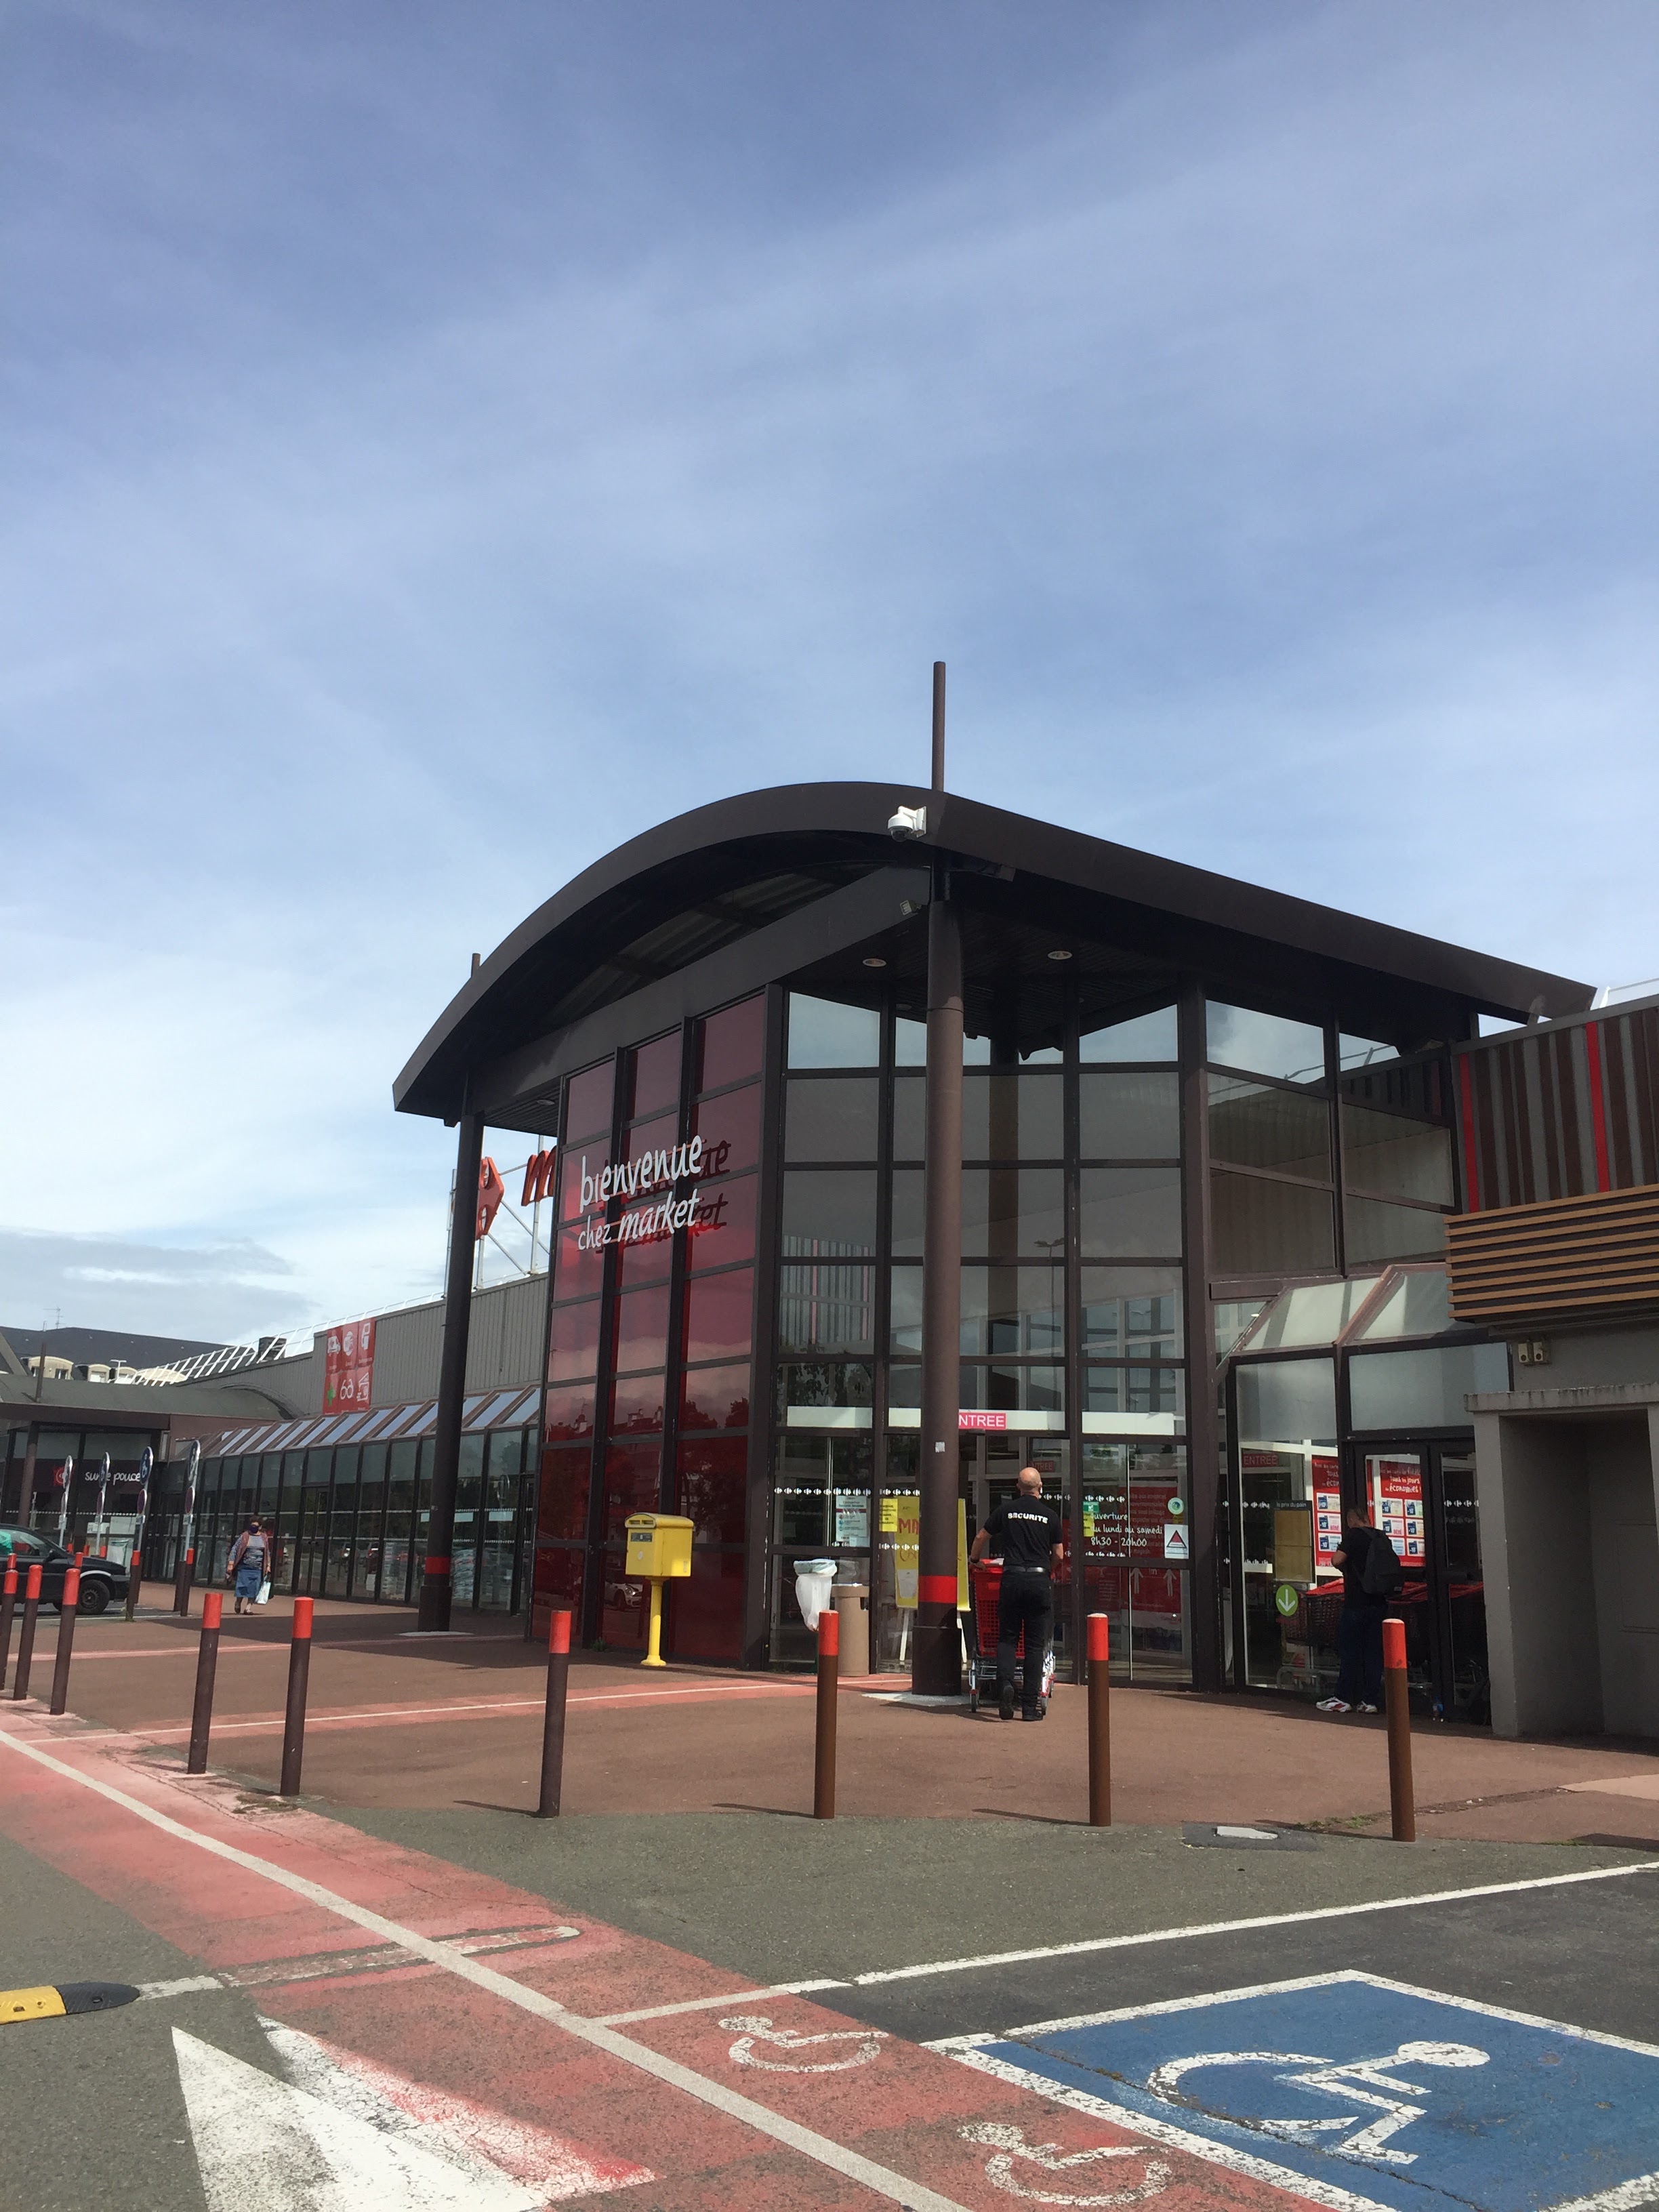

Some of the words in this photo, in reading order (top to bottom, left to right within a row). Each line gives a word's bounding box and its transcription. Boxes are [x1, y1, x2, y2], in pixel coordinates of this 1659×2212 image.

[579, 1134, 703, 1213] bienvenue
[578, 1215, 612, 1250] chez
[617, 1188, 700, 1243] market
[958, 1414, 1005, 1427] NTREE
[113, 1472, 141, 1486] pouce
[1326, 1477, 1340, 1488] écon
[1007, 1512, 1048, 1524] SECURITE
[898, 1517, 920, 1535] MA
[1103, 1523, 1122, 1534] lundi
[1136, 1525, 1163, 1534] samedi
[1090, 1536, 1112, 1547] 8h30
[1120, 1537, 1147, 1547] 20h00
